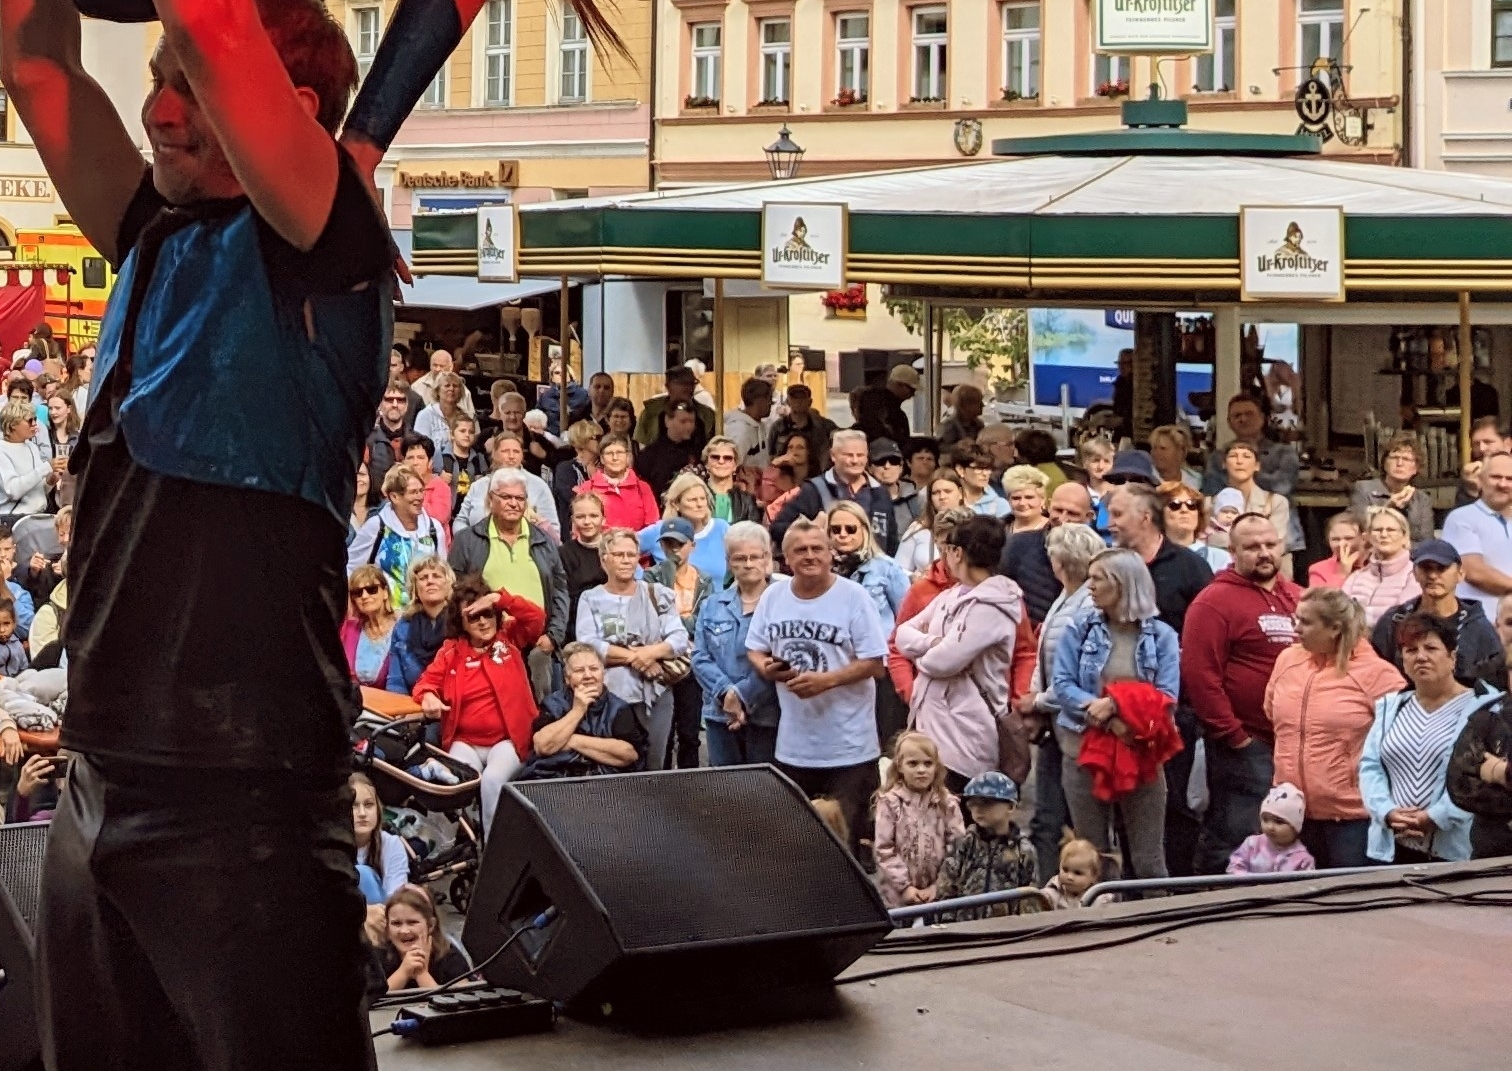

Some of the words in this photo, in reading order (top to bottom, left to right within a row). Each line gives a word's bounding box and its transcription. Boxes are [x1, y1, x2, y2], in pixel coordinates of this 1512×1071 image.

[399, 170, 459, 188] Deutsche
[460, 170, 495, 188] Bank
[767, 619, 846, 647] DIESEL
